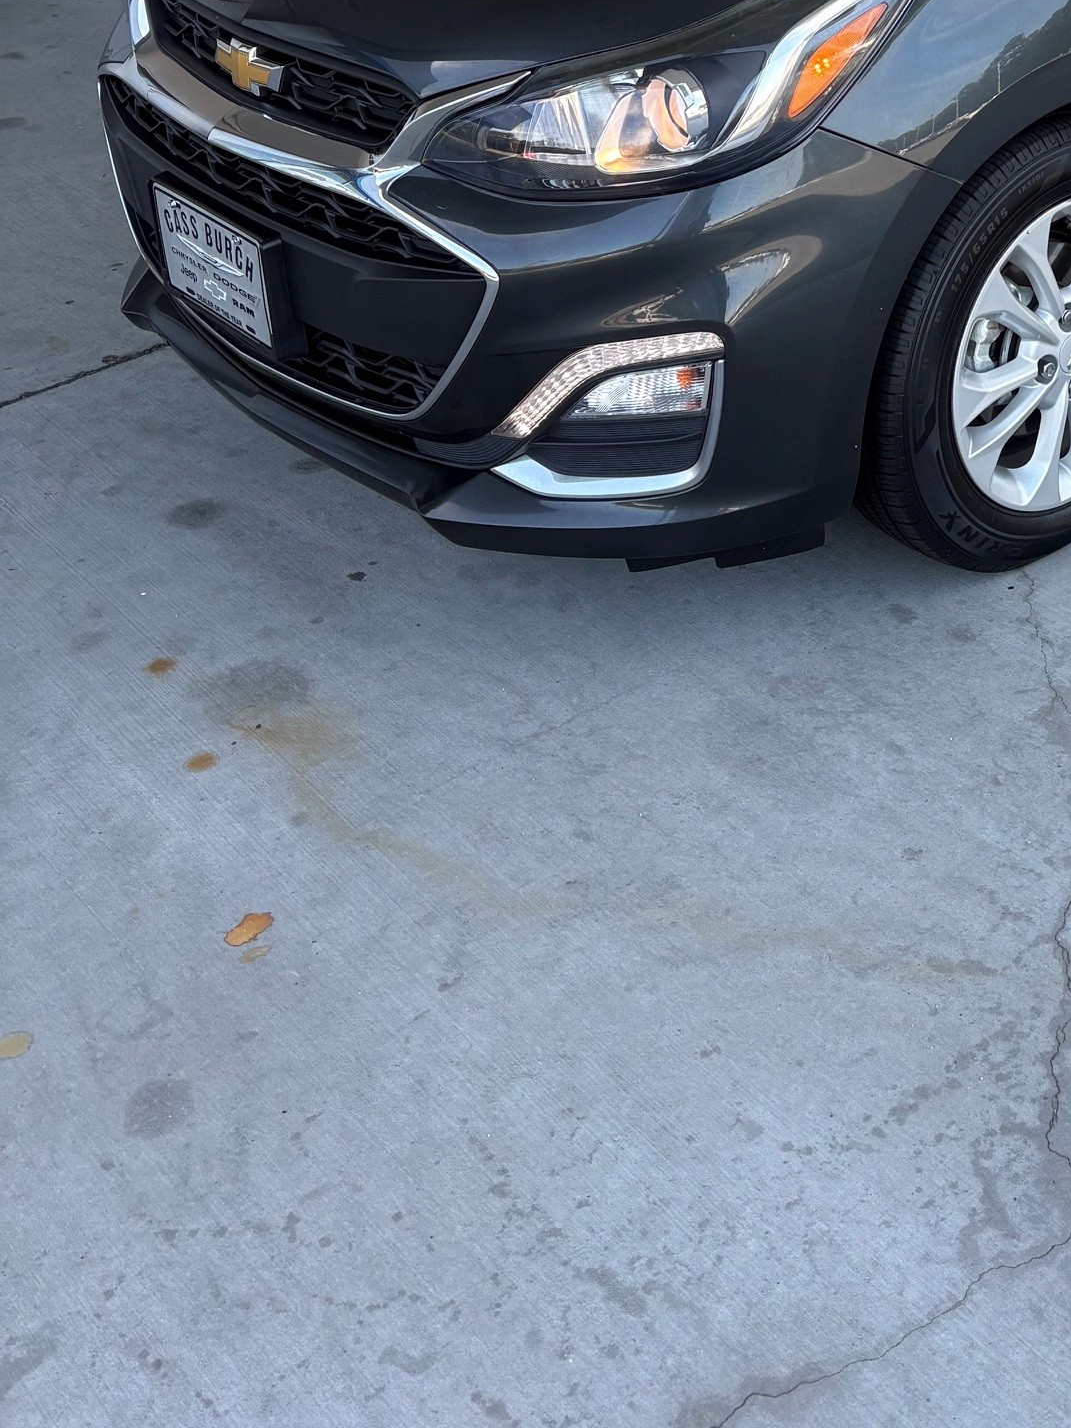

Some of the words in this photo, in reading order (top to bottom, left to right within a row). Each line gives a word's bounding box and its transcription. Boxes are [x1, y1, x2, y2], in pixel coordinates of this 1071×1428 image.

[163, 208, 199, 240] CASS
[204, 222, 254, 283] BURCH
[171, 246, 208, 274] CHRYSLER
[180, 263, 198, 283] Jeep
[213, 272, 256, 304] DODGE
[232, 298, 256, 318] RAM
